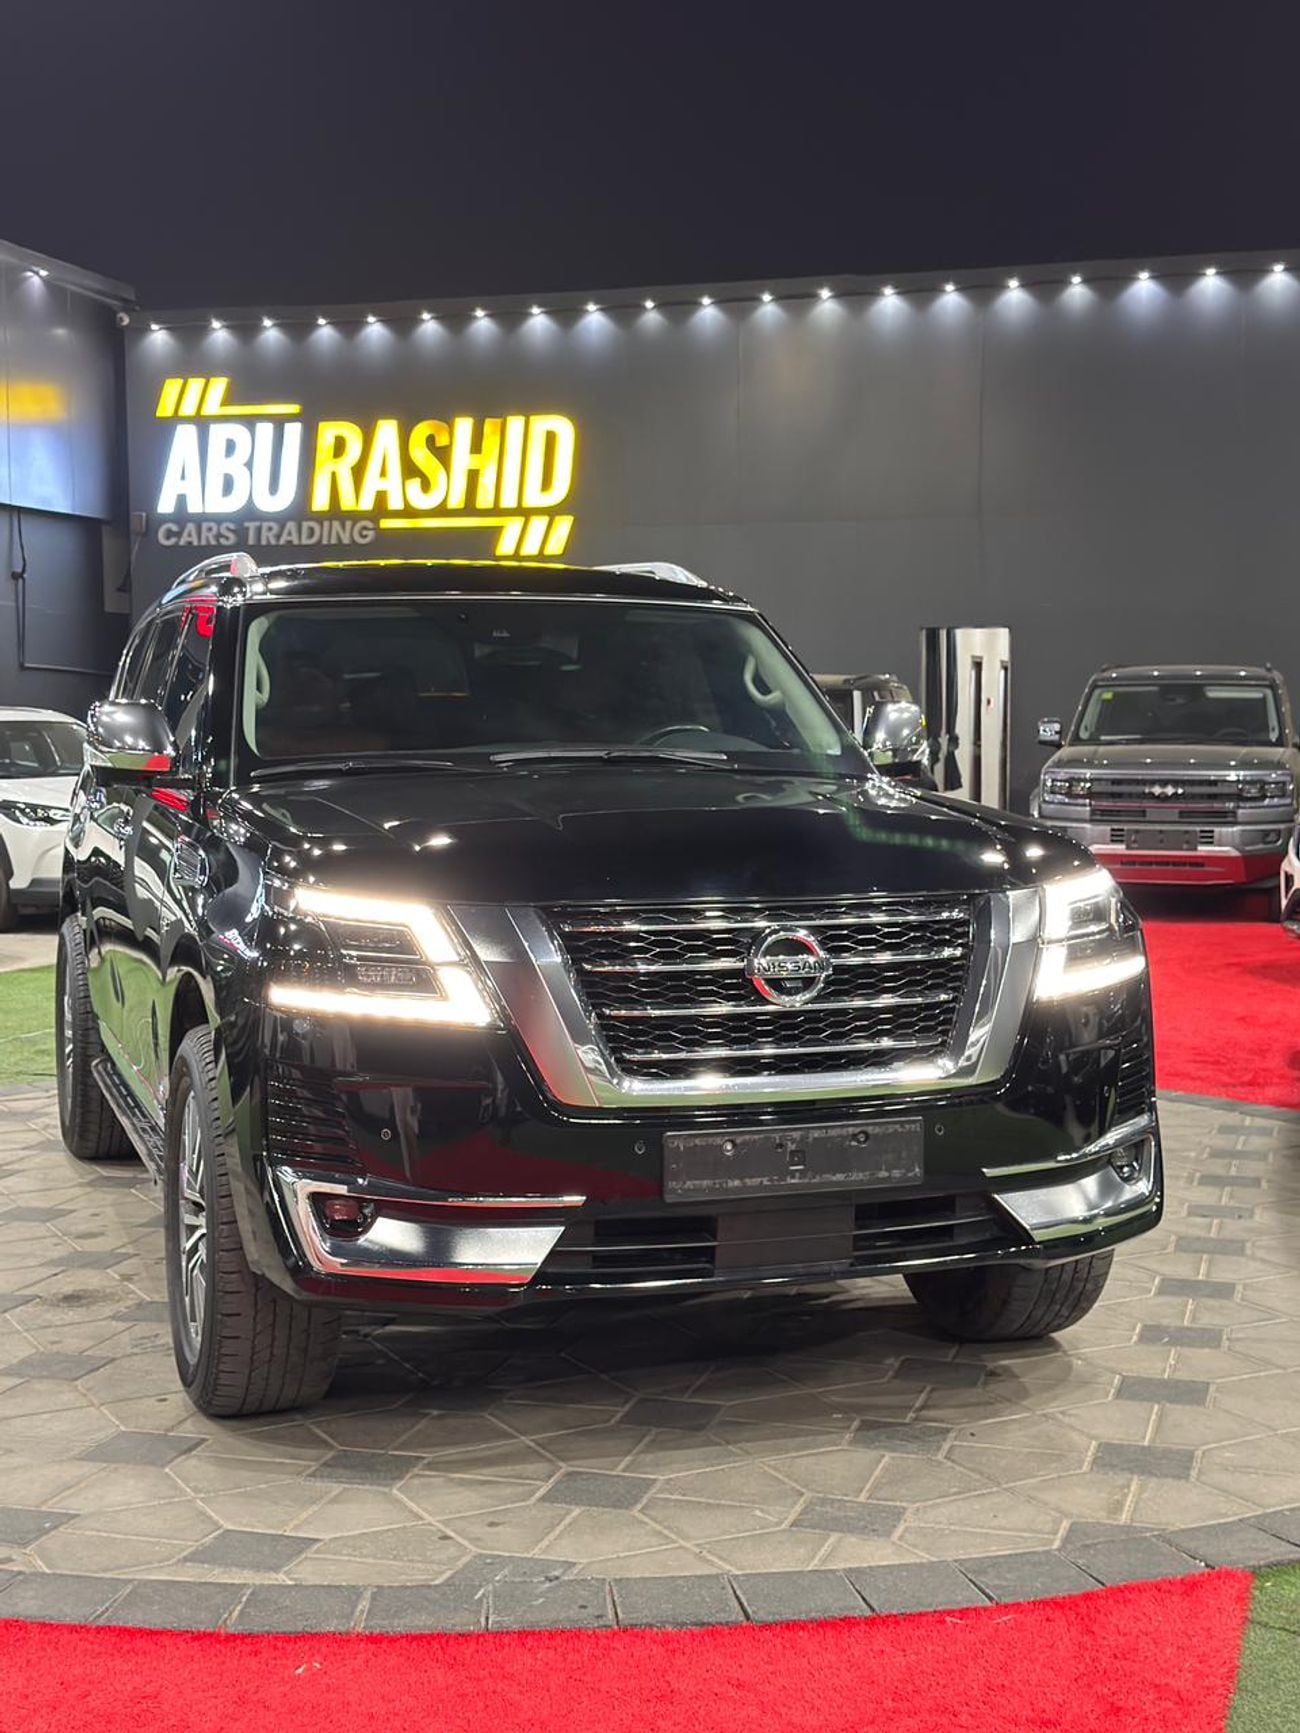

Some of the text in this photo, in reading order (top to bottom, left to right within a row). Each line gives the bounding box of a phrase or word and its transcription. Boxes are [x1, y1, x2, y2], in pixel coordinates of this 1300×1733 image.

[157, 415, 577, 514] ABU RASHID
[157, 519, 377, 547] CARS TRADING
[756, 960, 826, 974] NISSAN
